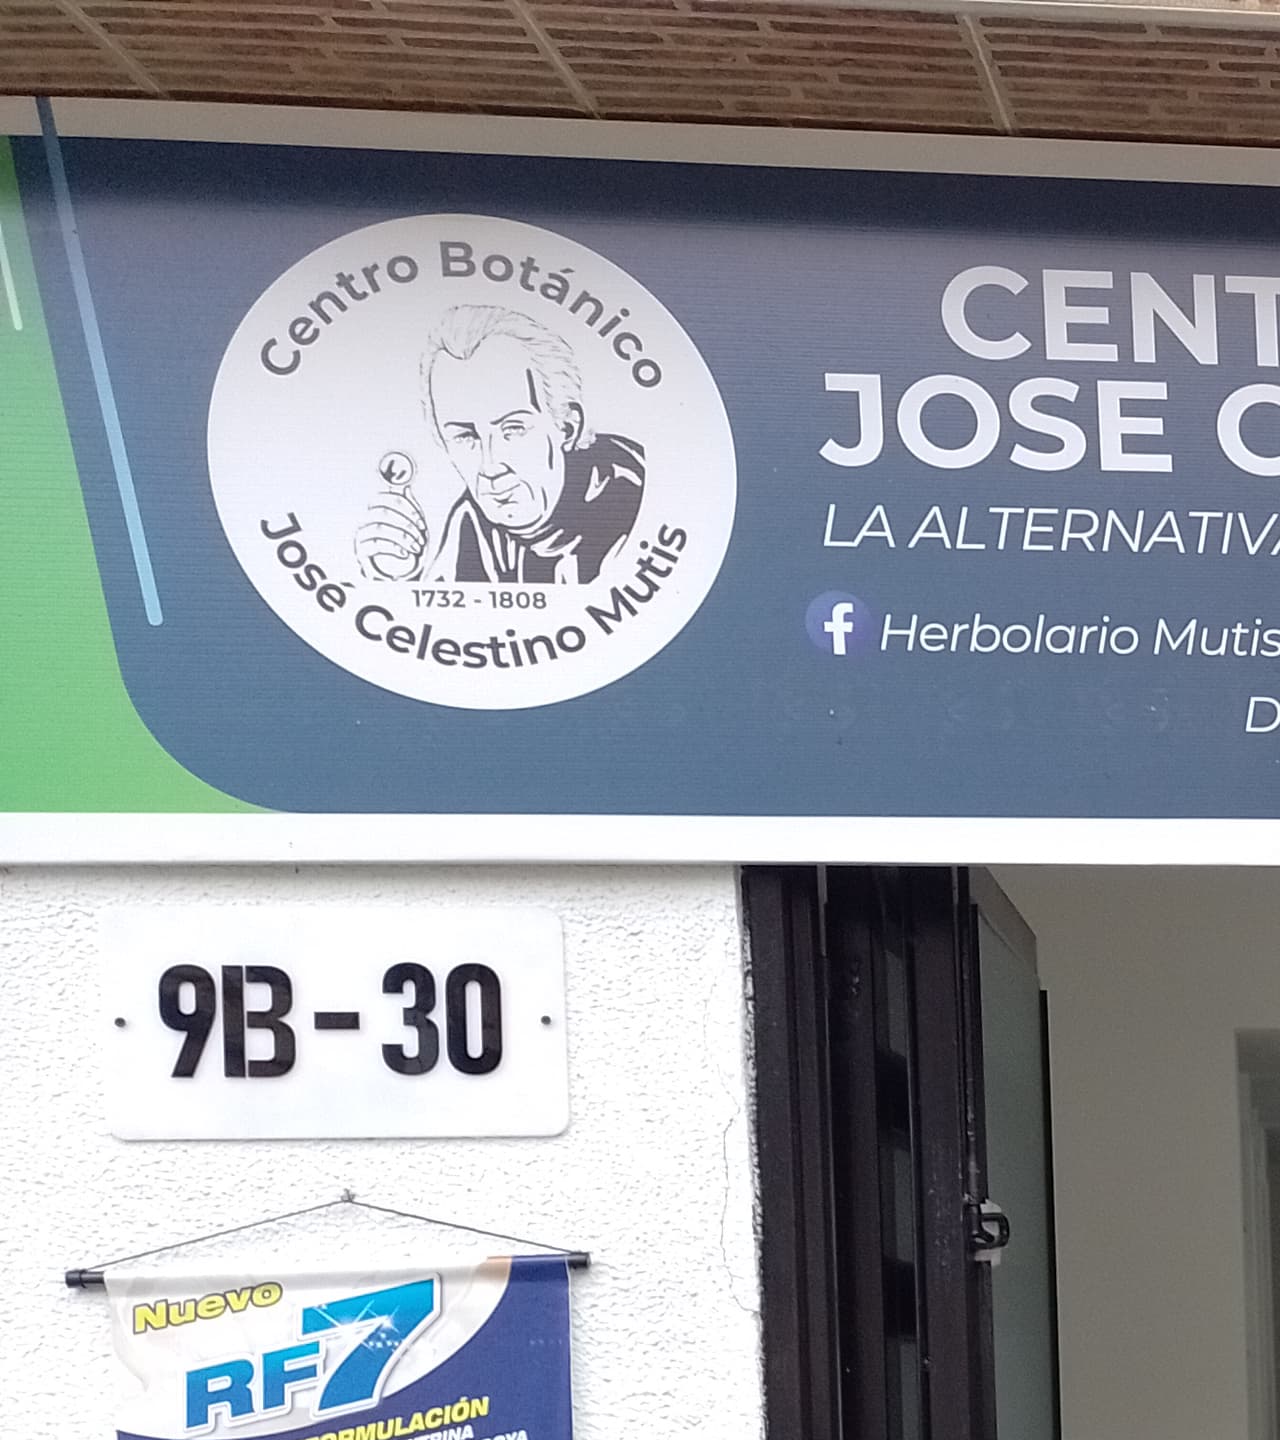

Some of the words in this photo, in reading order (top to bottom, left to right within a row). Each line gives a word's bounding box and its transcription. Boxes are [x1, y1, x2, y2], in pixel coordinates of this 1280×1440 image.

[260, 253, 419, 376] Centro
[439, 240, 662, 388] Botánico
[818, 372, 1173, 473] JOSE
[823, 503, 896, 549] LA
[260, 512, 356, 612] José
[354, 604, 585, 669] Celestino
[584, 523, 688, 635] Mutis
[412, 590, 466, 608] 1732
[491, 591, 547, 609] 1808
[880, 611, 1138, 658] Herbolario
[133, 1281, 283, 1335] Nuevo
[184, 1276, 438, 1430] RF7
